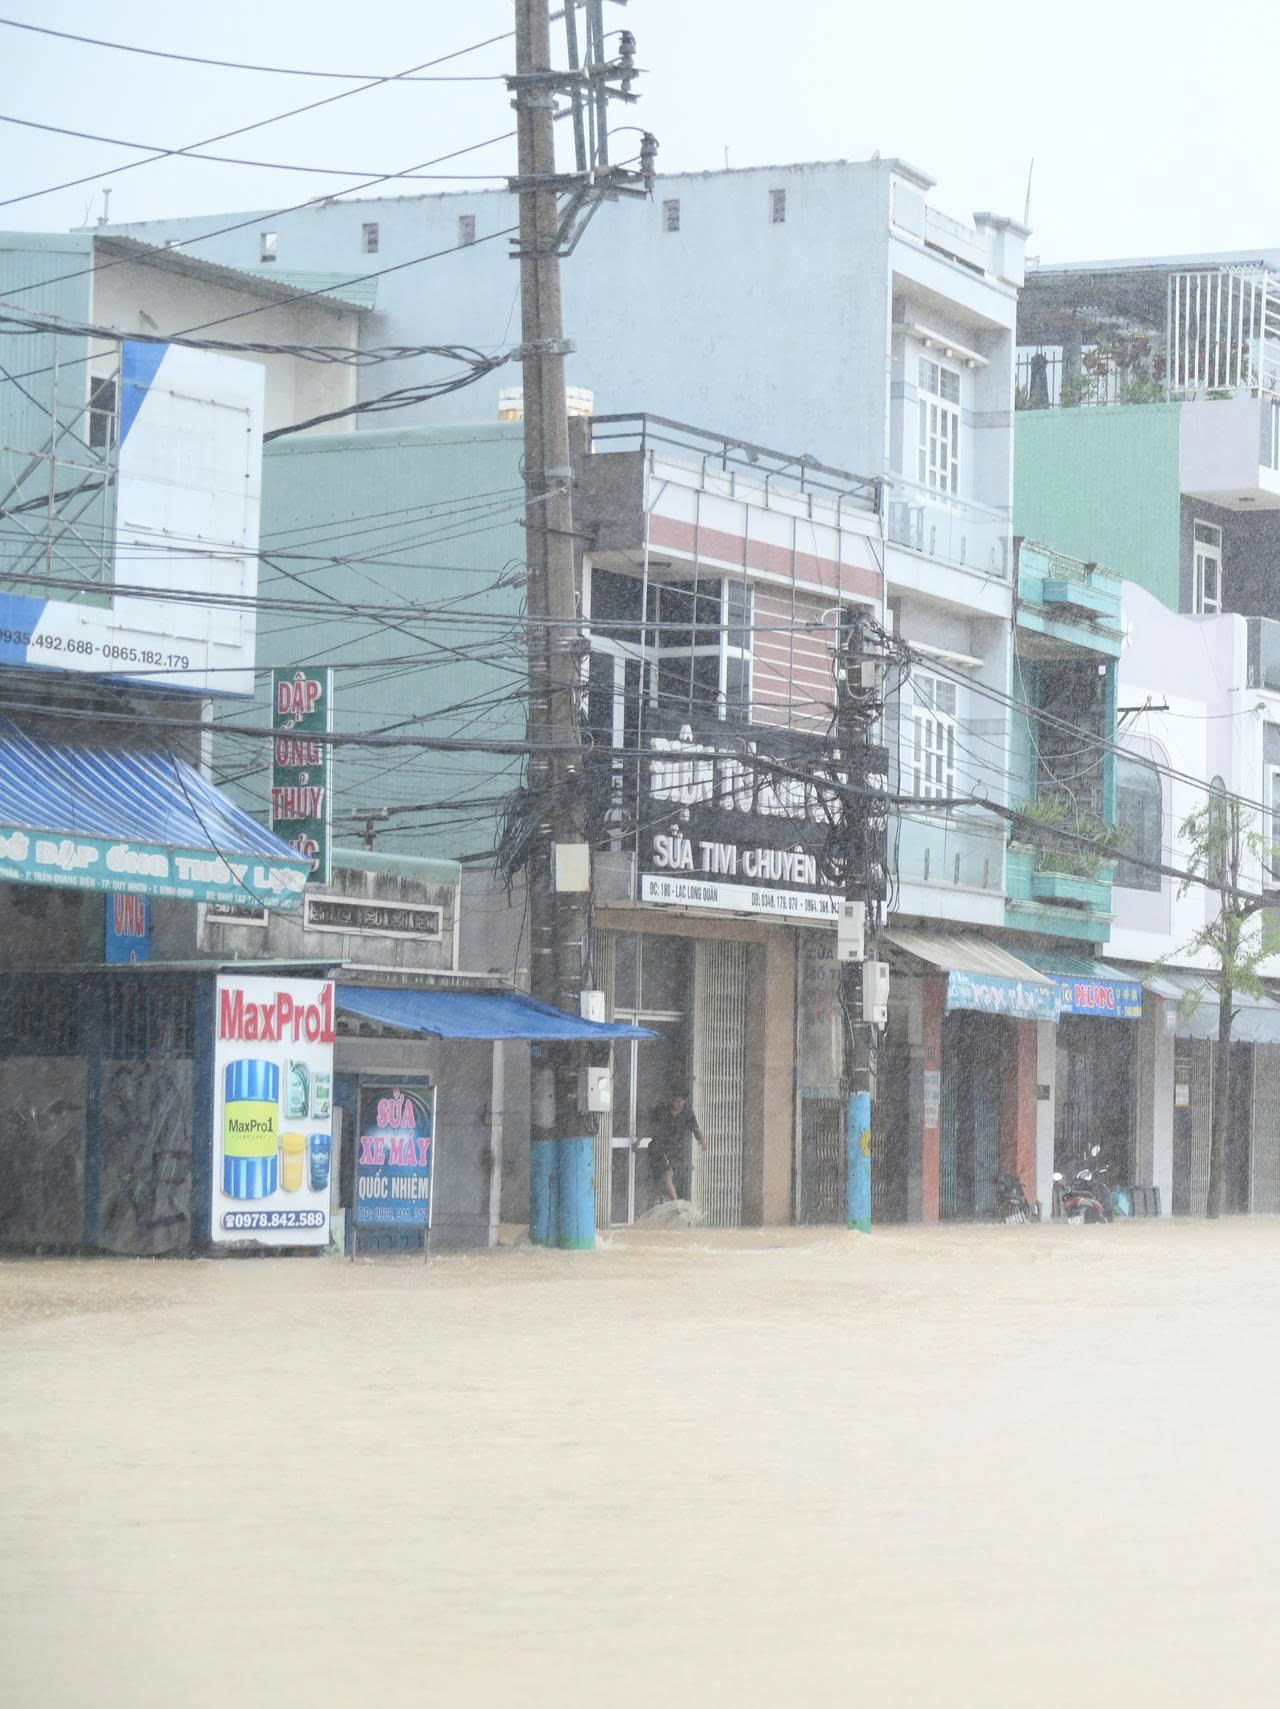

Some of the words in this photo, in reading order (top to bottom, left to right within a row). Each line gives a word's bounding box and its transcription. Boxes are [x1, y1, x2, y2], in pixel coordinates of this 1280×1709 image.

[278, 671, 323, 722] DẬP
[272, 771, 325, 820] THỦY
[35, 840, 98, 870] DẬP
[106, 844, 168, 878] ỐNG
[176, 854, 248, 887] THỦY
[254, 866, 307, 894] LỰC
[653, 824, 694, 870] SỬA
[742, 846, 816, 886] CHUYÊN
[676, 884, 687, 901] LẠC
[688, 886, 702, 900] LONG
[703, 885, 718, 902] QUÂN
[219, 983, 335, 1043] MaxPro1
[228, 1116, 274, 1133] MaxPro1
[377, 1088, 416, 1129] SỬA
[360, 1135, 386, 1166] XE
[388, 1129, 431, 1167] MÁY
[359, 1169, 388, 1201] QUỐC
[391, 1172, 429, 1204] NHIỆM
[235, 1212, 323, 1228] 0978.842.588
